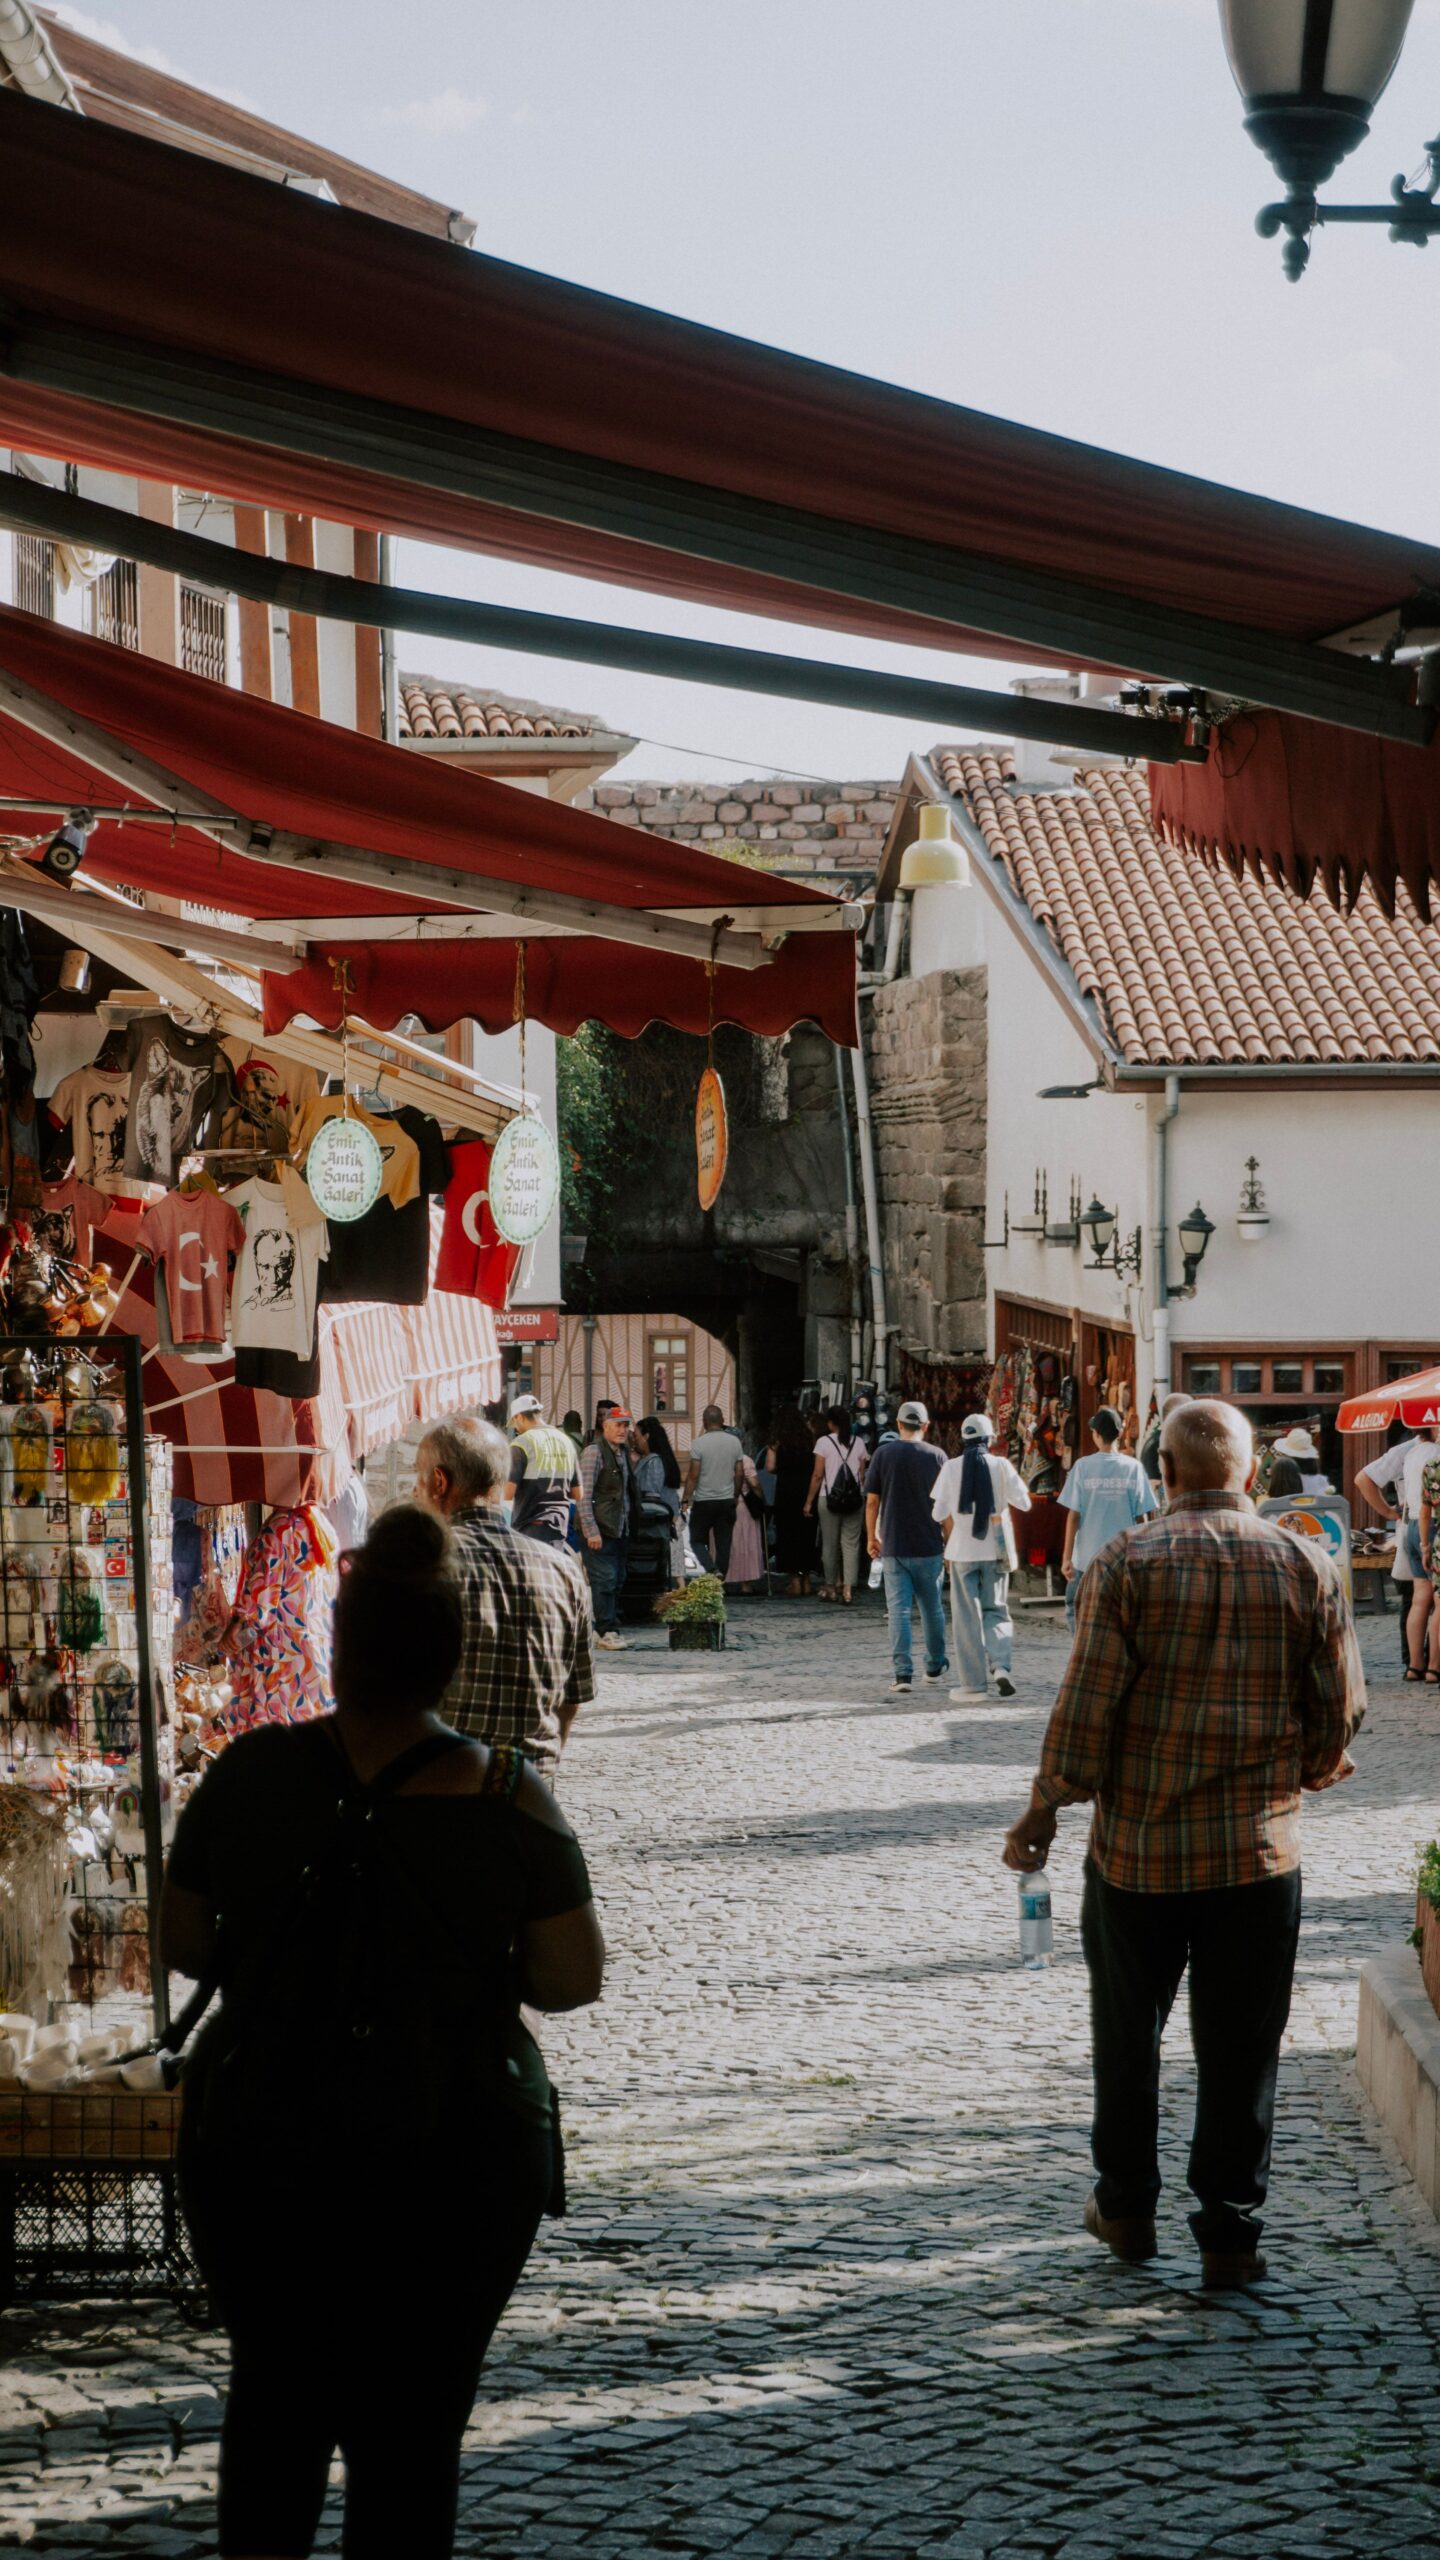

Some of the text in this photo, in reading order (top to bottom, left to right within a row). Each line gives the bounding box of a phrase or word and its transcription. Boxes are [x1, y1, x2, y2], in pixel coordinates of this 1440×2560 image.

[328, 1132, 361, 1150] Emir
[510, 1130, 539, 1150] Emir
[321, 1151, 364, 1167] Antik
[503, 1152, 540, 1169] Antik
[323, 1167, 366, 1185] Sanat
[504, 1172, 542, 1191] Sanat
[323, 1185, 365, 1203] Galeri
[502, 1196, 539, 1217] Galeri
[1351, 1411, 1386, 1428] ALGIDA
